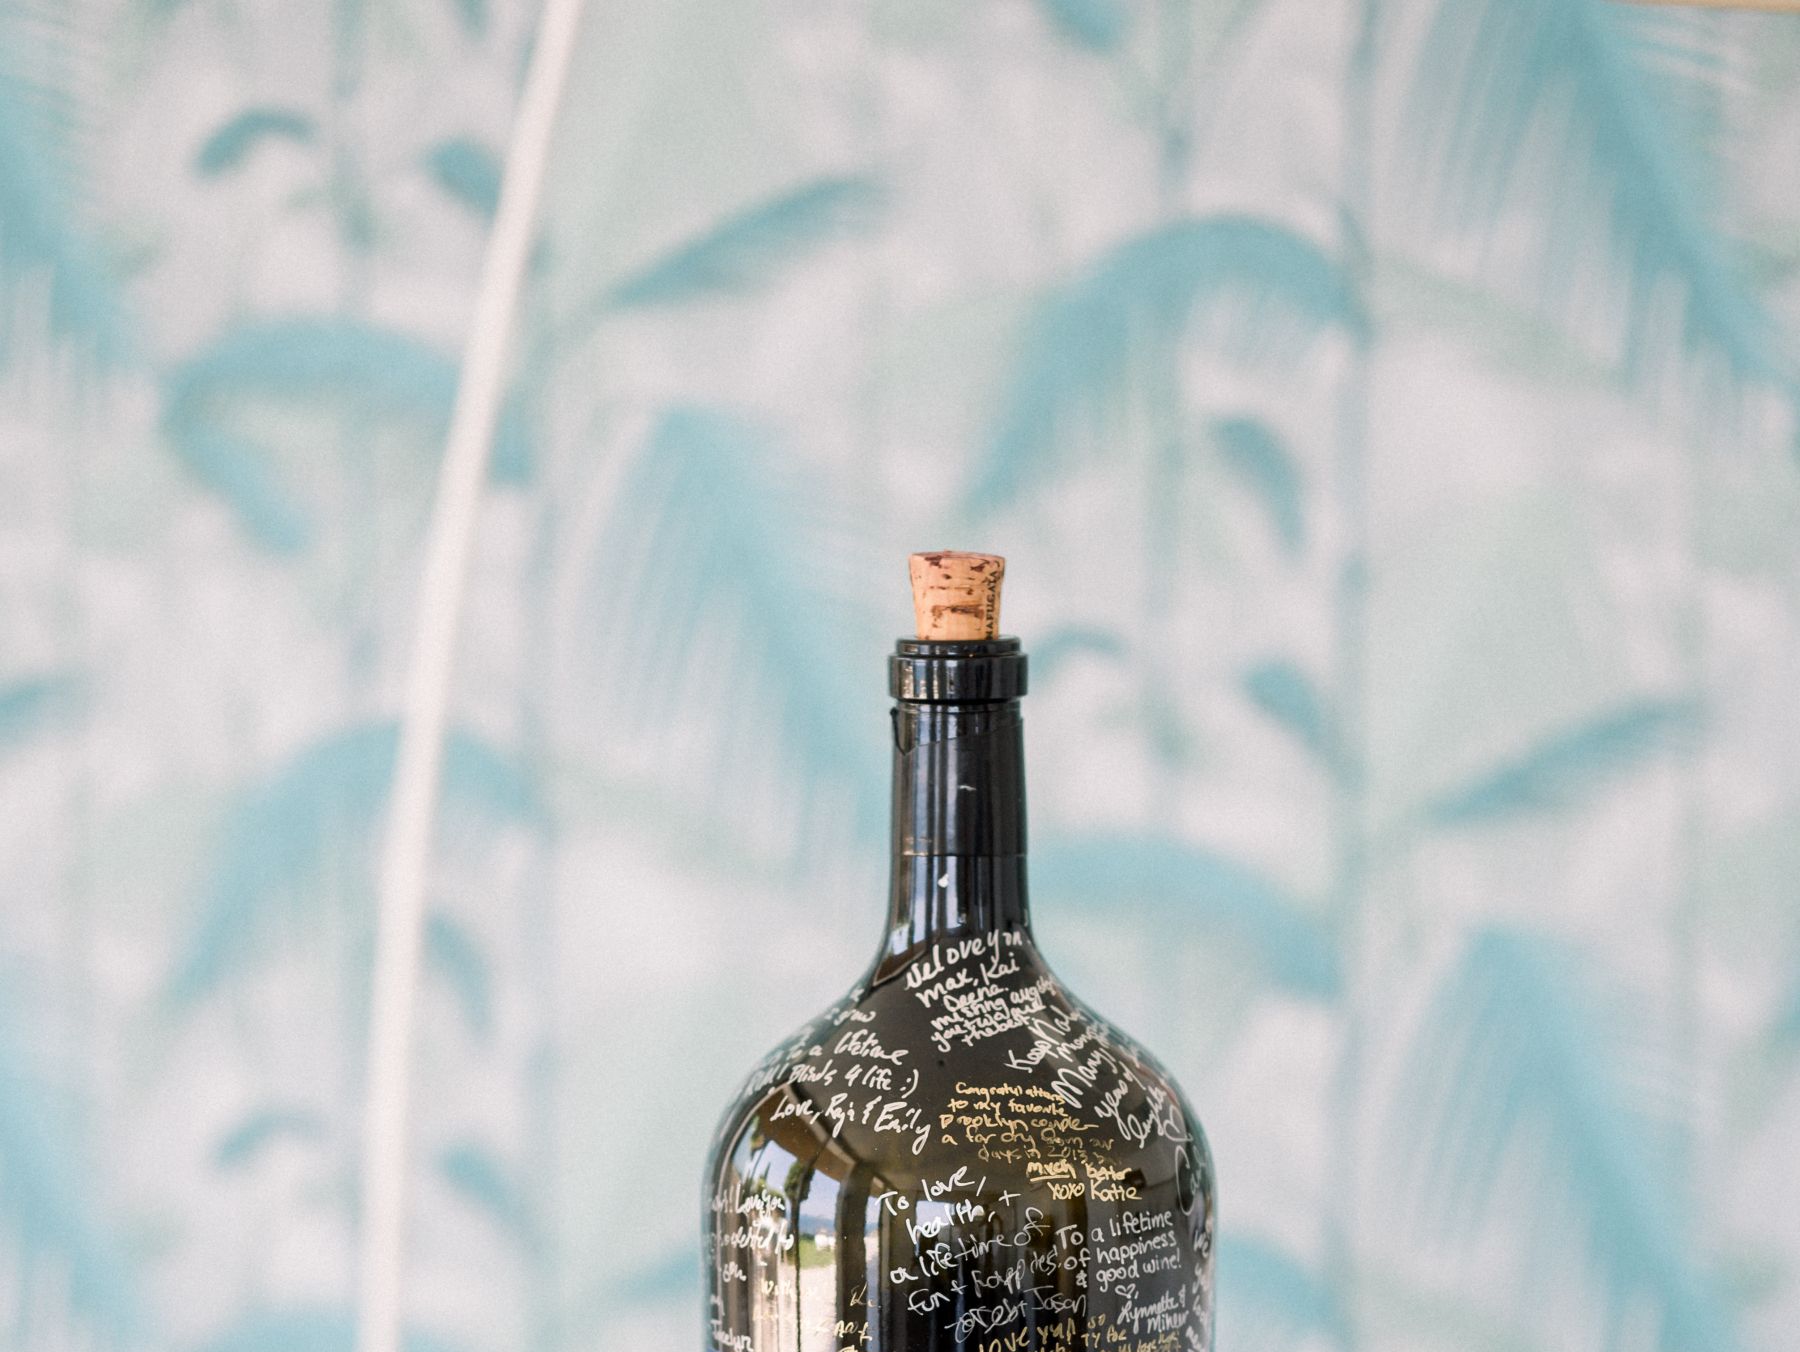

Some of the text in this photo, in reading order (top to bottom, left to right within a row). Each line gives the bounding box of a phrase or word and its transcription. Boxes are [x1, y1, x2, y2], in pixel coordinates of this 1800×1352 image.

[1109, 1211, 1173, 1237] lifetime
[1097, 1230, 1177, 1264] happiness
[1096, 1259, 1140, 1293] good
